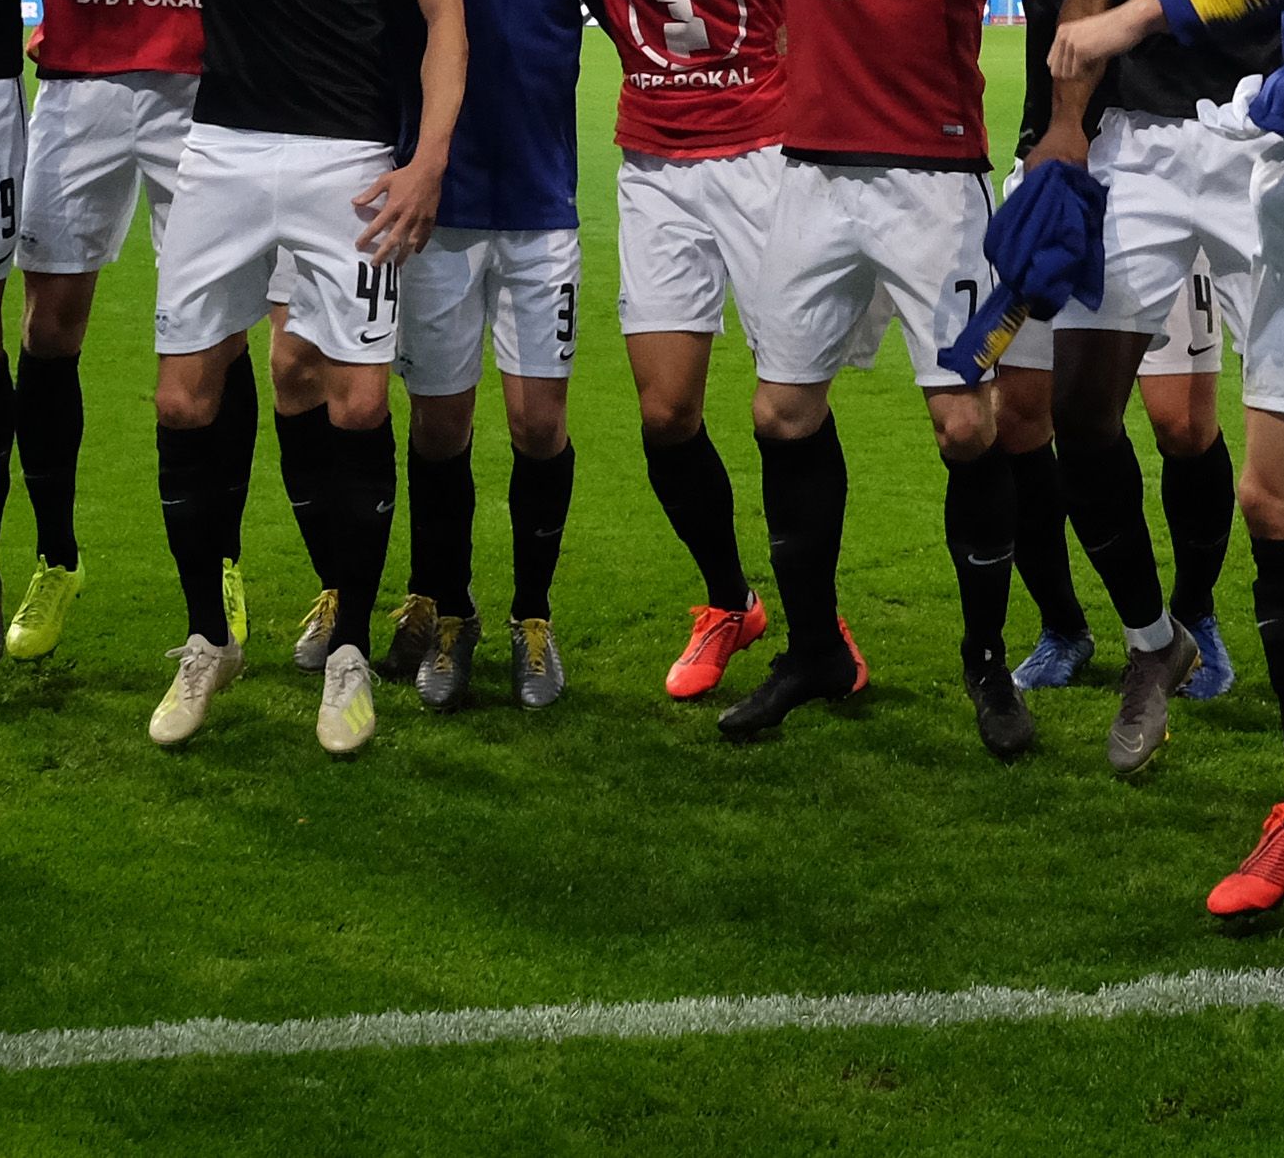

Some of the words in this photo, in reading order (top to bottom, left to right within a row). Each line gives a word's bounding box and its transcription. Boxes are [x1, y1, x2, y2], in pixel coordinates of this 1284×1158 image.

[0, 176, 16, 240] 9
[356, 260, 398, 324] 44
[954, 279, 978, 326] 7
[1193, 274, 1214, 334] 4
